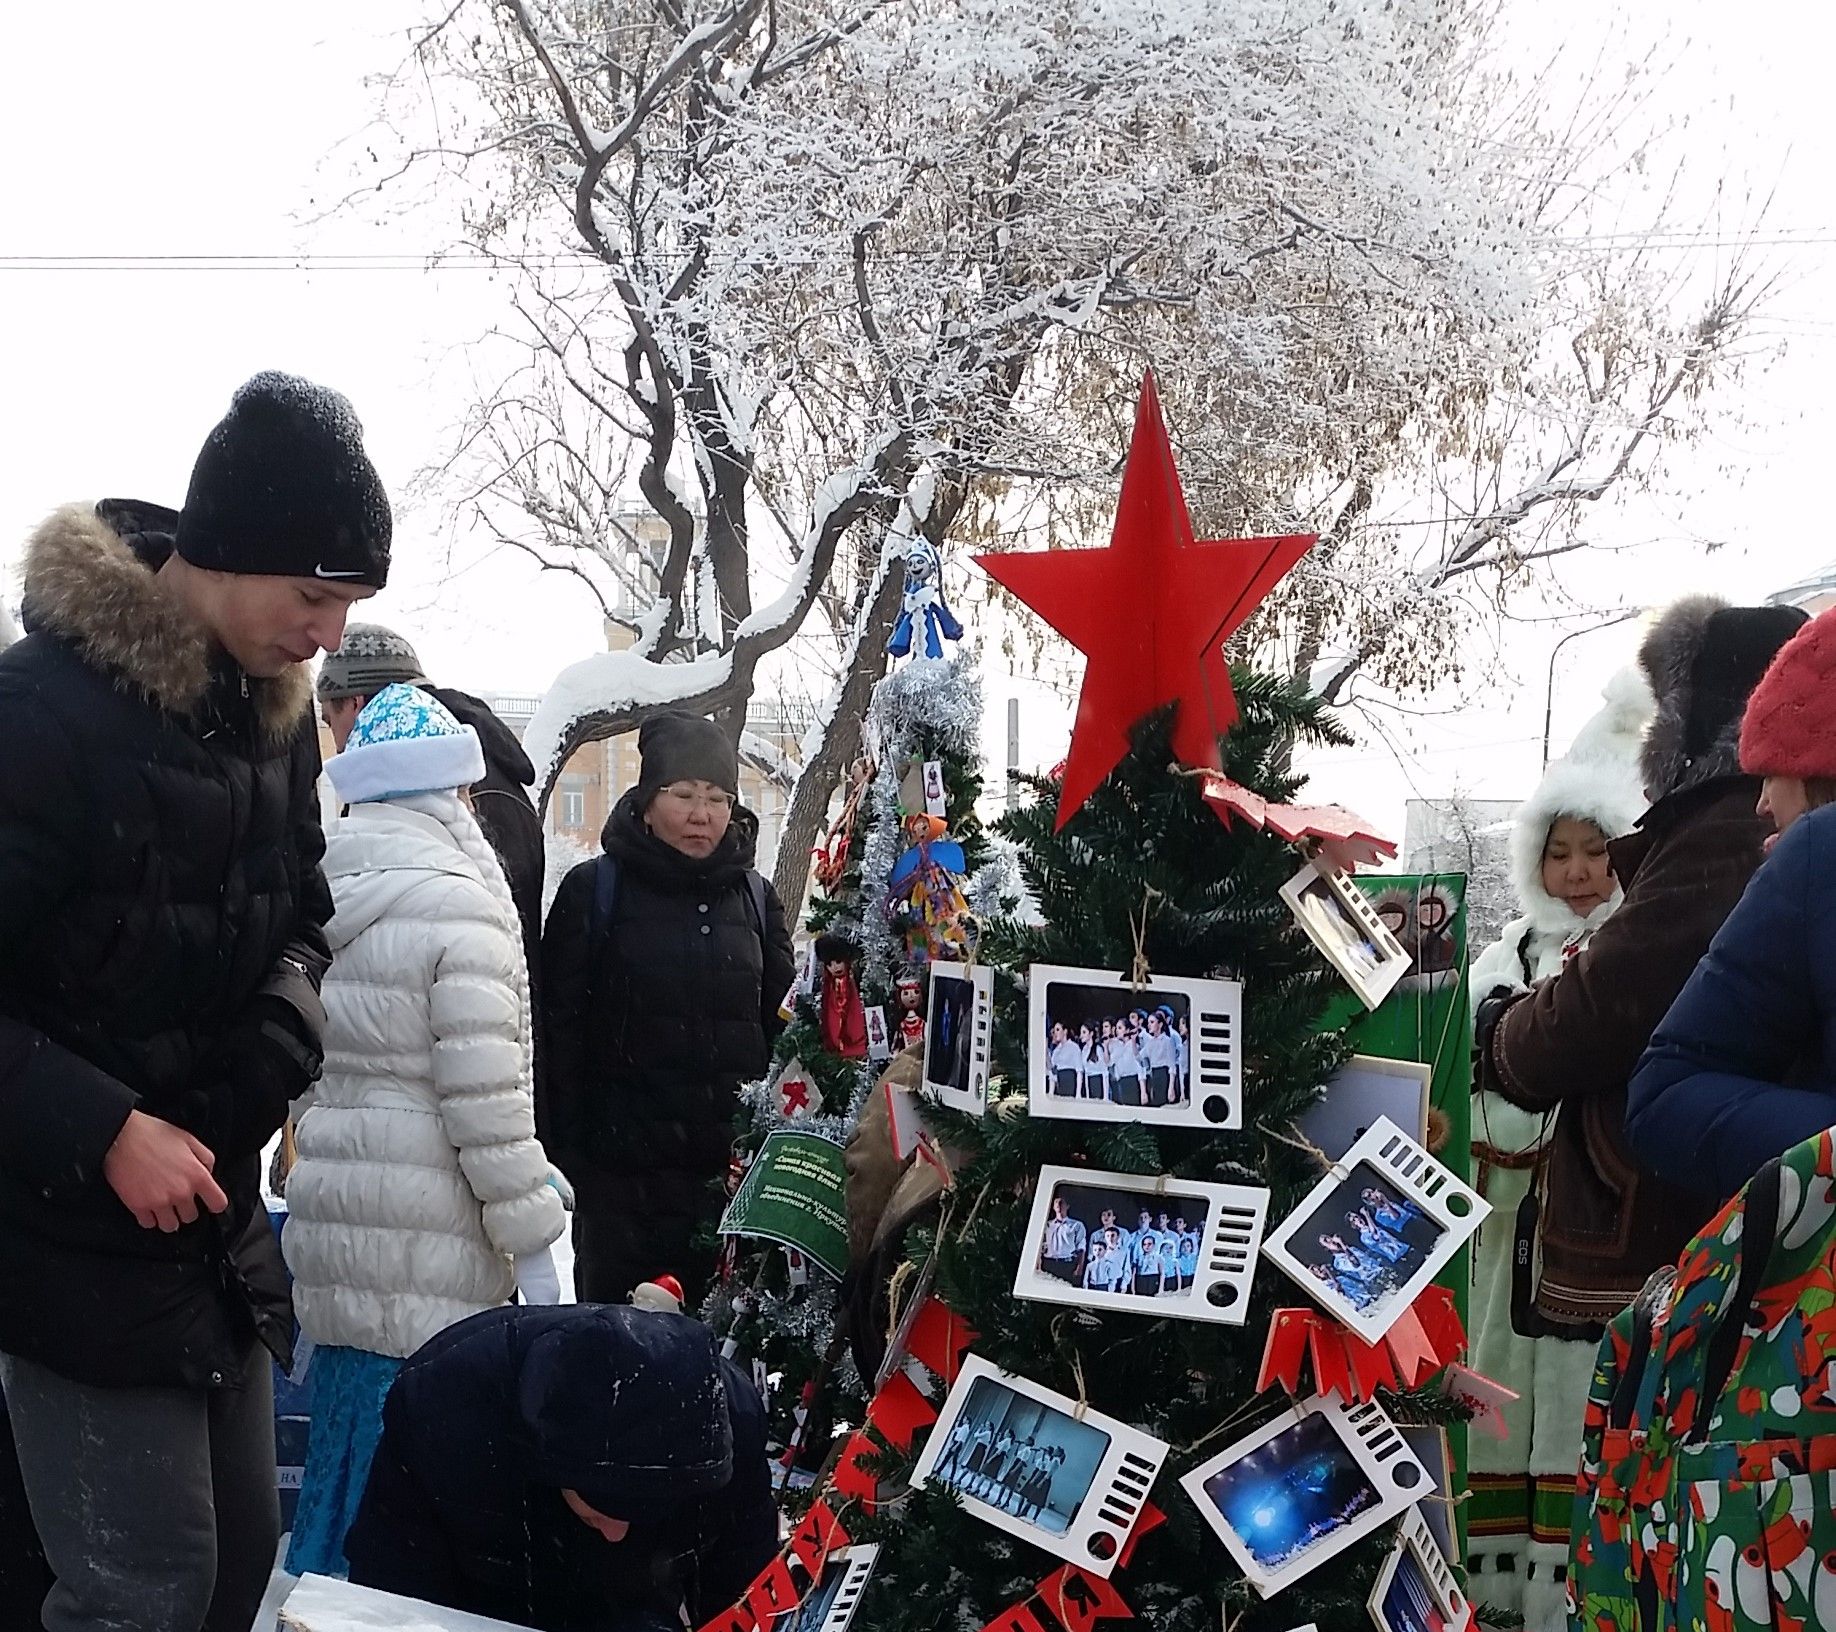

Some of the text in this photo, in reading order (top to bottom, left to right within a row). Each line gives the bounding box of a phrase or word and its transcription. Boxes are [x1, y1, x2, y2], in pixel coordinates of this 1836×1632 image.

[801, 1160, 842, 1183] красивая
[763, 1184, 847, 1226] Национально-культур
[1518, 1239, 1529, 1265] EOS
